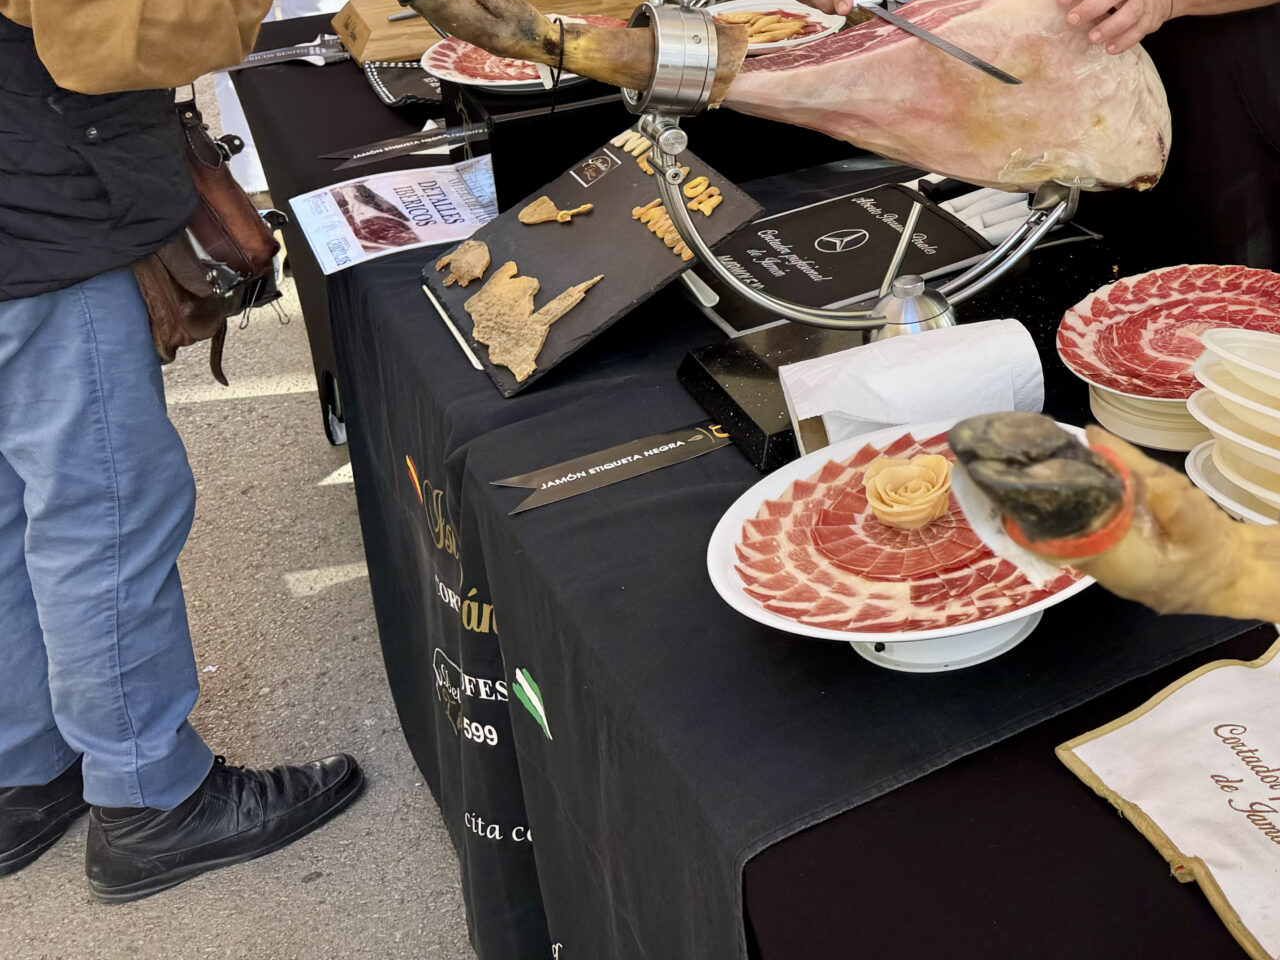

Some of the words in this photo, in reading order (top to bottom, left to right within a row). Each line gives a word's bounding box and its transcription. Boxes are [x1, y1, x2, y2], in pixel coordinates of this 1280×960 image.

[393, 185, 437, 227] IBÉRICOS
[418, 180, 465, 225] DETALLES
[540, 470, 587, 490] JAMÓN
[588, 453, 643, 475] ETIQUETA
[643, 440, 686, 457] NEGRA
[462, 716, 499, 747] 599
[1210, 773, 1245, 794] de
[465, 812, 504, 841] cita
